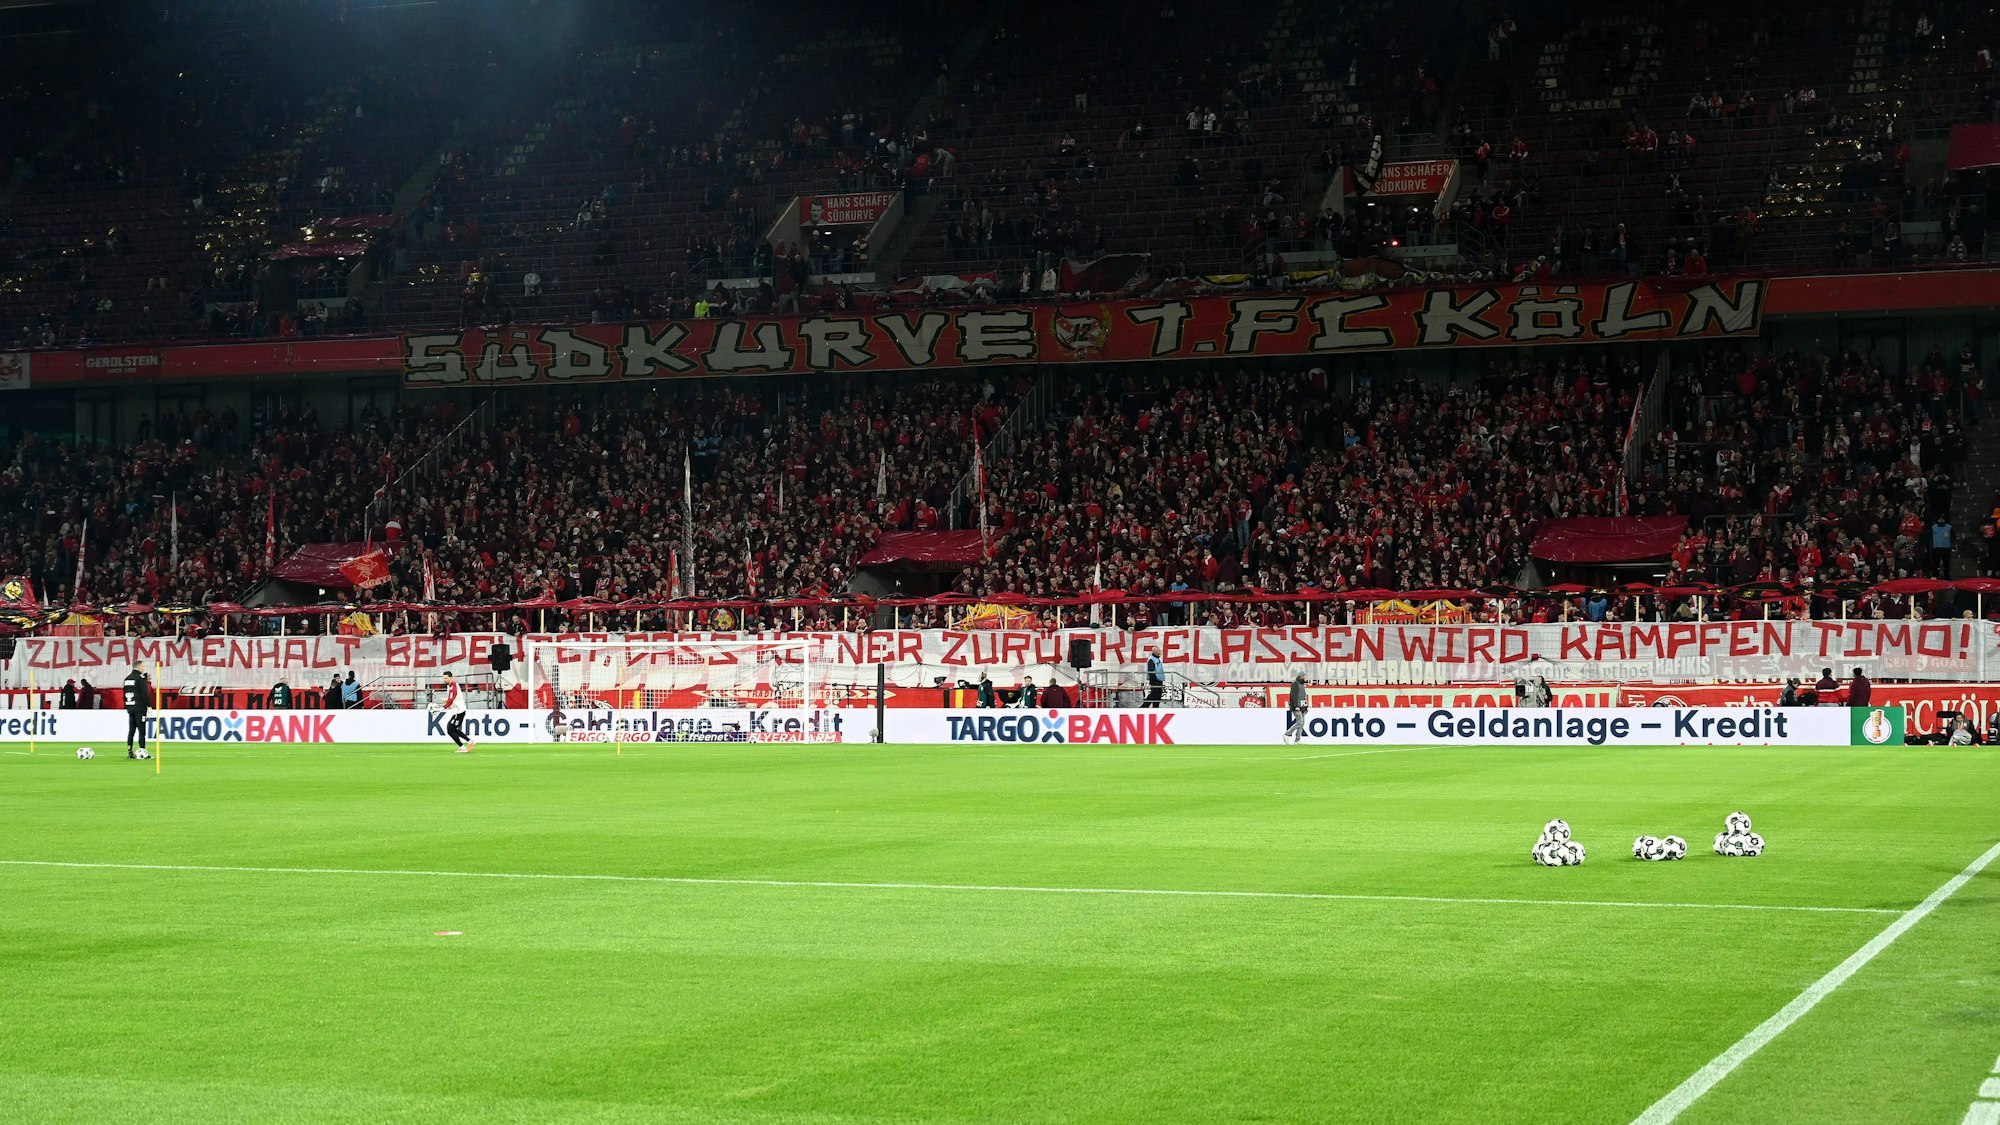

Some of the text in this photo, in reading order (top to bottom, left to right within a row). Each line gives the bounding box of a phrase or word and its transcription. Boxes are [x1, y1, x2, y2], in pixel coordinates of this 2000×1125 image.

[1378, 166, 1401, 178] ANS
[1374, 179, 1428, 192] SÜDKURVE
[827, 197, 851, 209] HANS
[827, 209, 875, 222] SÜDKURVE
[404, 309, 1038, 384] SÜDKURVE
[1411, 279, 1764, 346] KÖLN
[86, 355, 159, 368] GEROLSTEIN
[26, 636, 361, 669] ZUSAMMENHALT
[1398, 626, 1528, 664] WIRD
[1560, 621, 1793, 661] KÄMPFEN
[1812, 621, 1971, 660] TIMO!
[245, 714, 336, 742] BANK
[427, 711, 510, 737] Knto
[946, 714, 1175, 744] TARGO BANK
[1427, 709, 1630, 745] Geldanlage
[1674, 708, 1788, 738] Kredit
[689, 731, 730, 742] freenet
